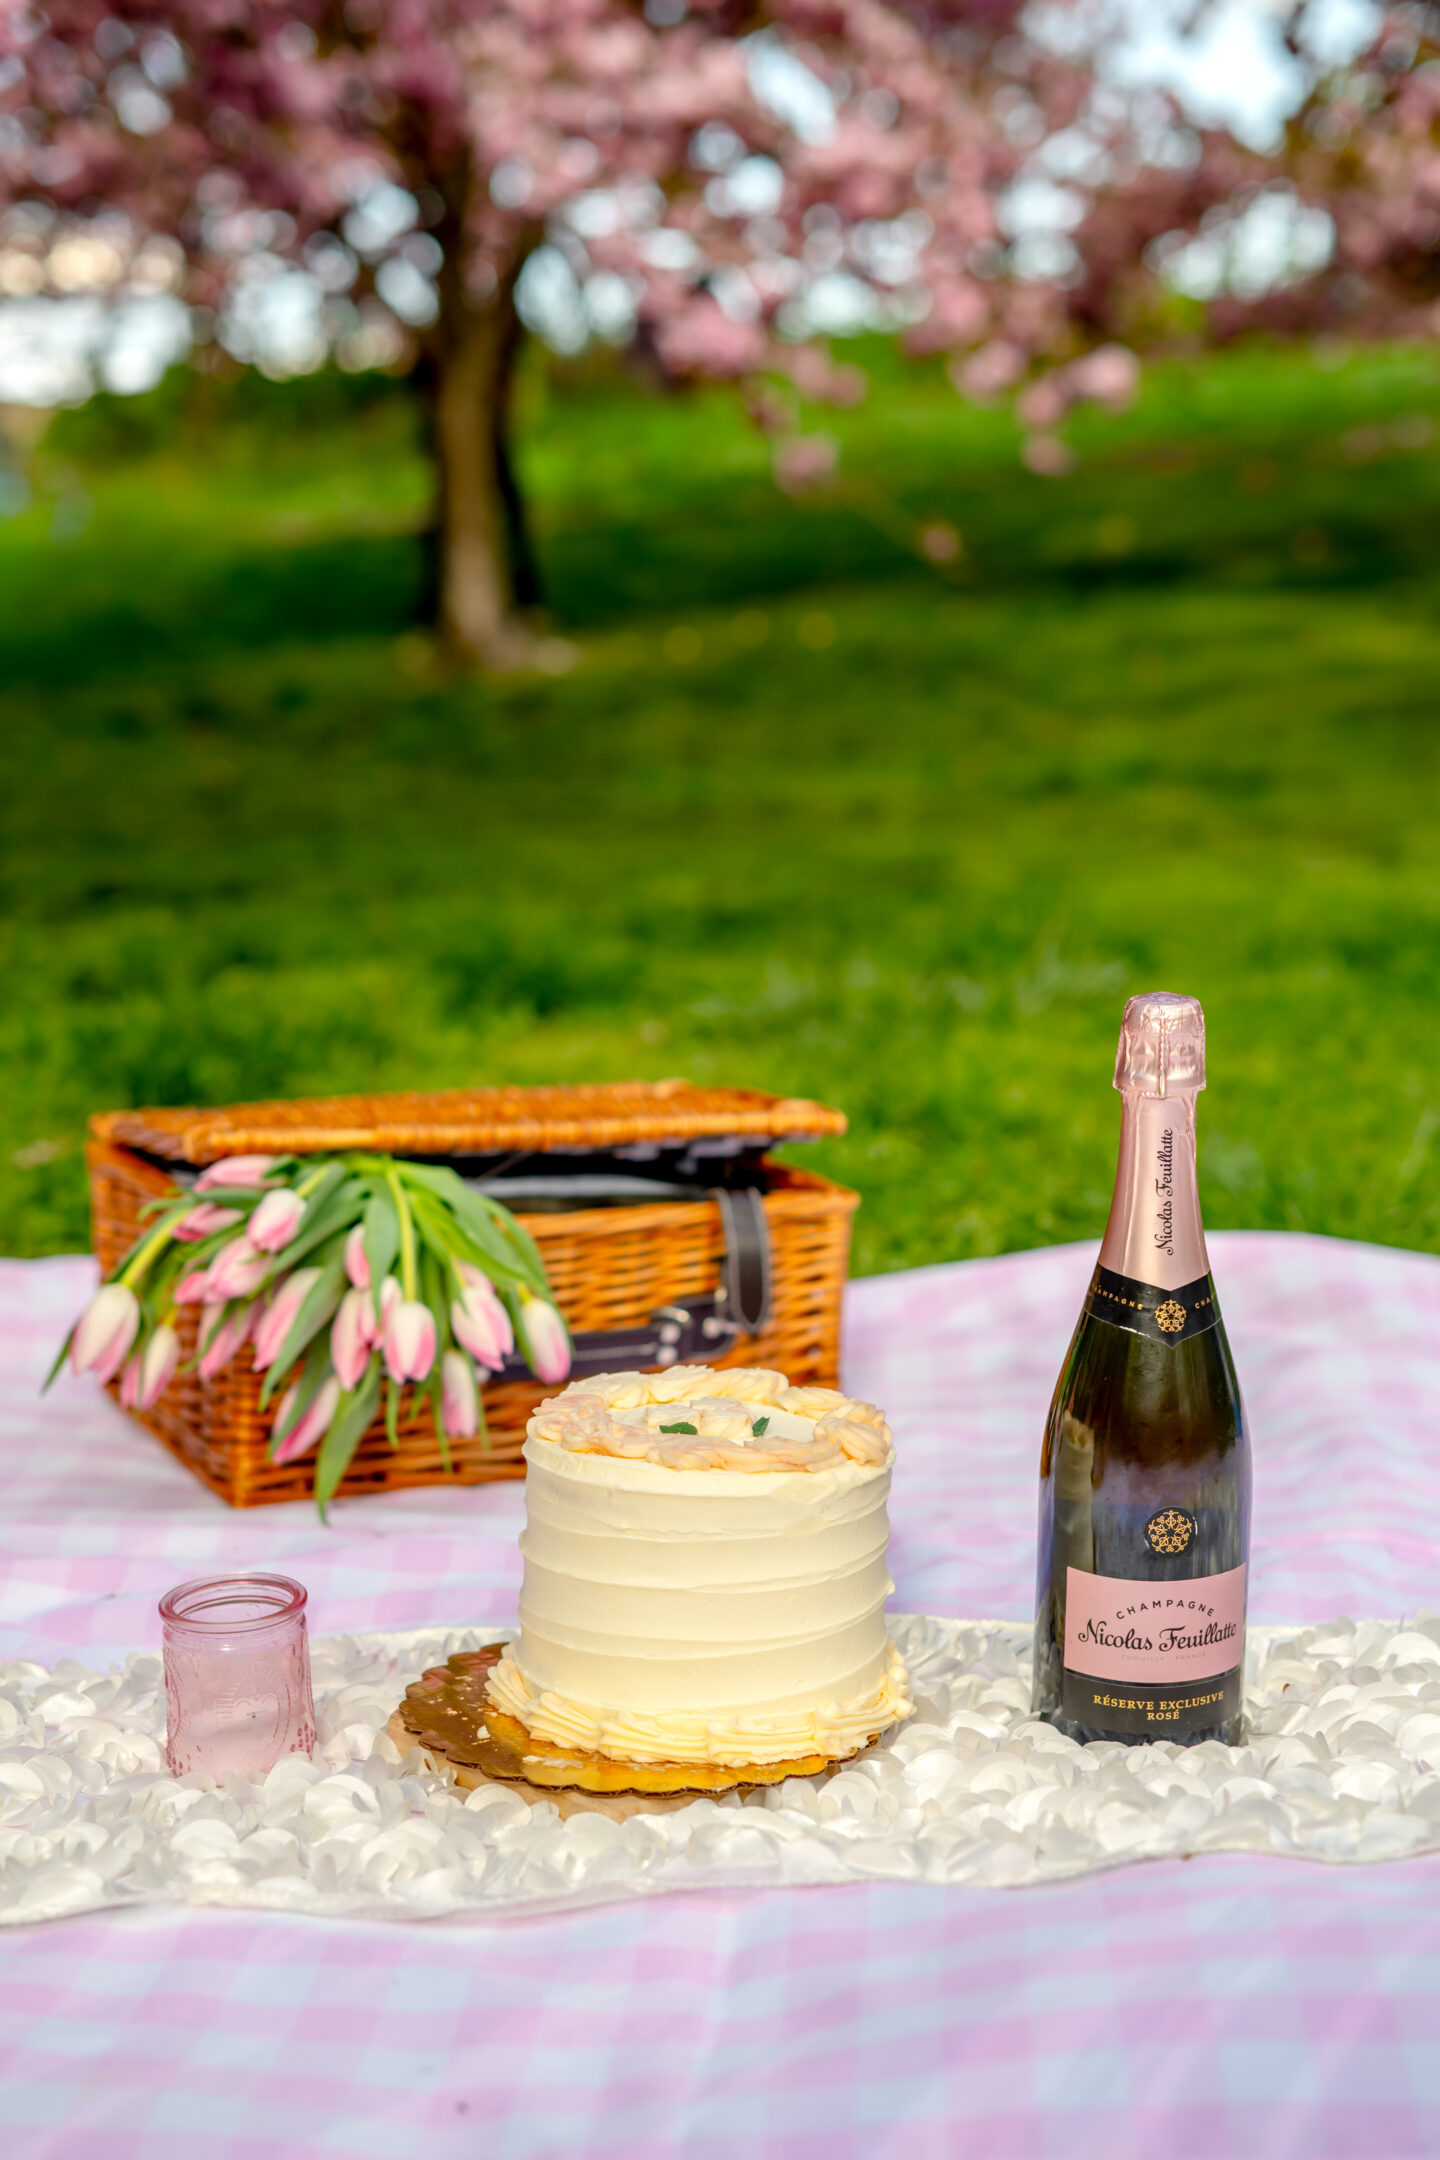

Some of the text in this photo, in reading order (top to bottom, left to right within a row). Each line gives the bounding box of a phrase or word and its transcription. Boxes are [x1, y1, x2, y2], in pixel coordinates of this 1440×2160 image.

[1155, 1127, 1174, 1256] Nicolas Feuillatte
[1116, 1599, 1215, 1620] CHAMPAGNE
[1077, 1618, 1237, 1652] Nicolas Feuillatte
[1092, 1691, 1224, 1711] RÉSERVE EXCLUSIVE
[1146, 1709, 1180, 1721] ROSÉ
